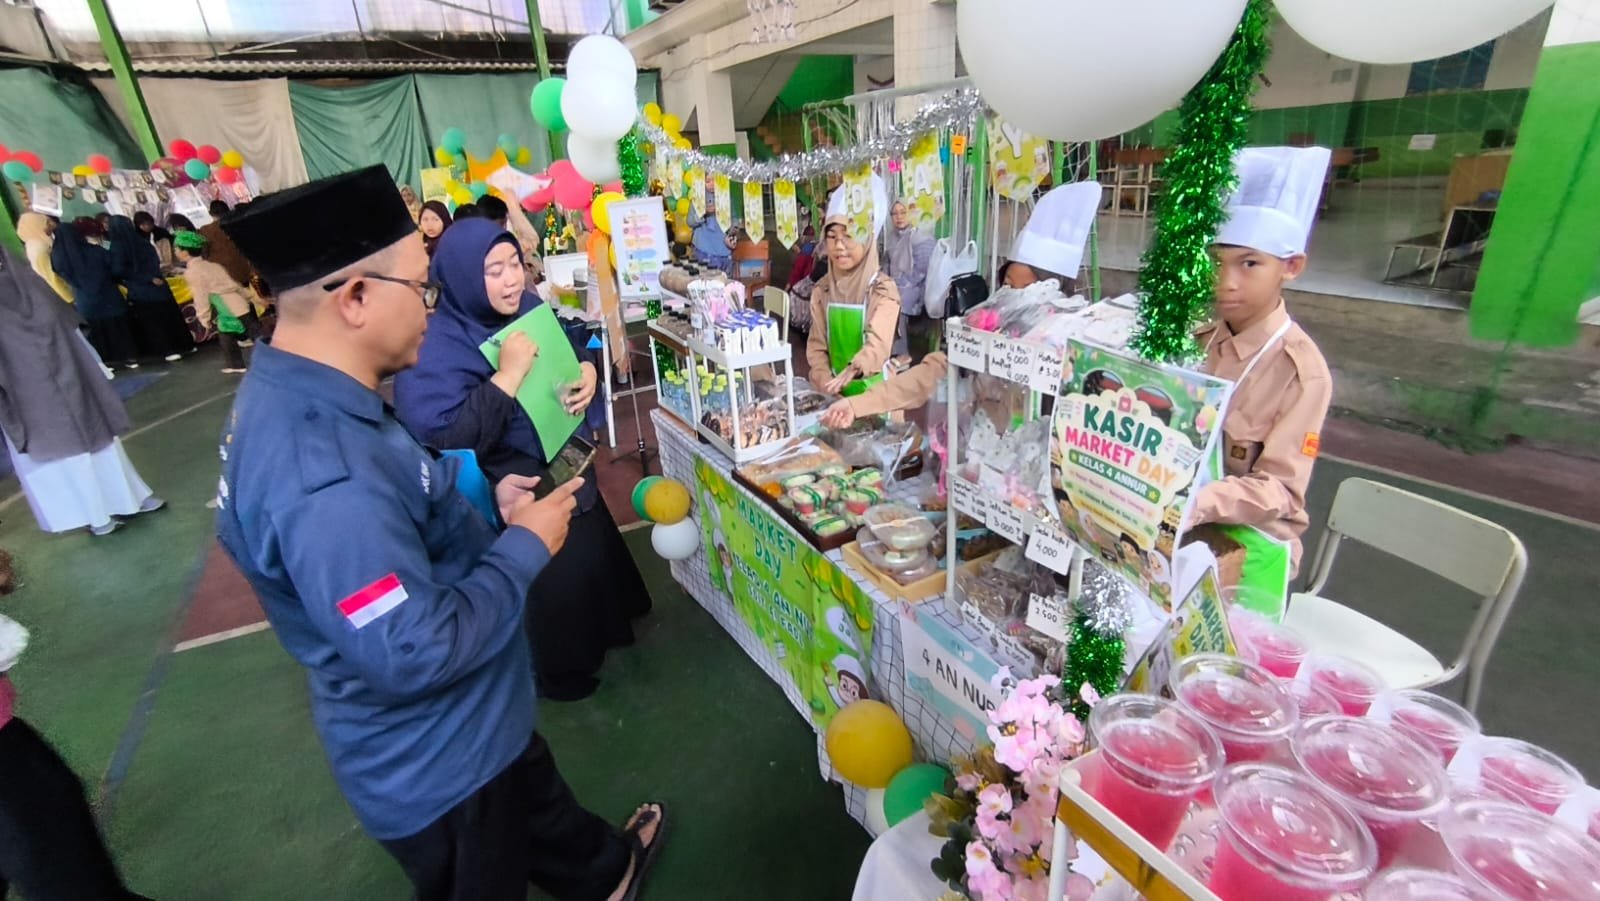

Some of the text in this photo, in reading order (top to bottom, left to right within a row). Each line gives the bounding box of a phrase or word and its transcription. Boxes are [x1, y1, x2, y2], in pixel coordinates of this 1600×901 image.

[1084, 403, 1163, 456] KASIR
[1065, 426, 1177, 487] MARKET DAY
[1078, 454, 1105, 474] KELAS
[1106, 466, 1113, 477] 4
[1114, 470, 1148, 495] ANNUR
[738, 498, 796, 562] MARKET
[754, 536, 782, 579] DAY
[922, 648, 931, 666] 4
[936, 657, 958, 690] AN
